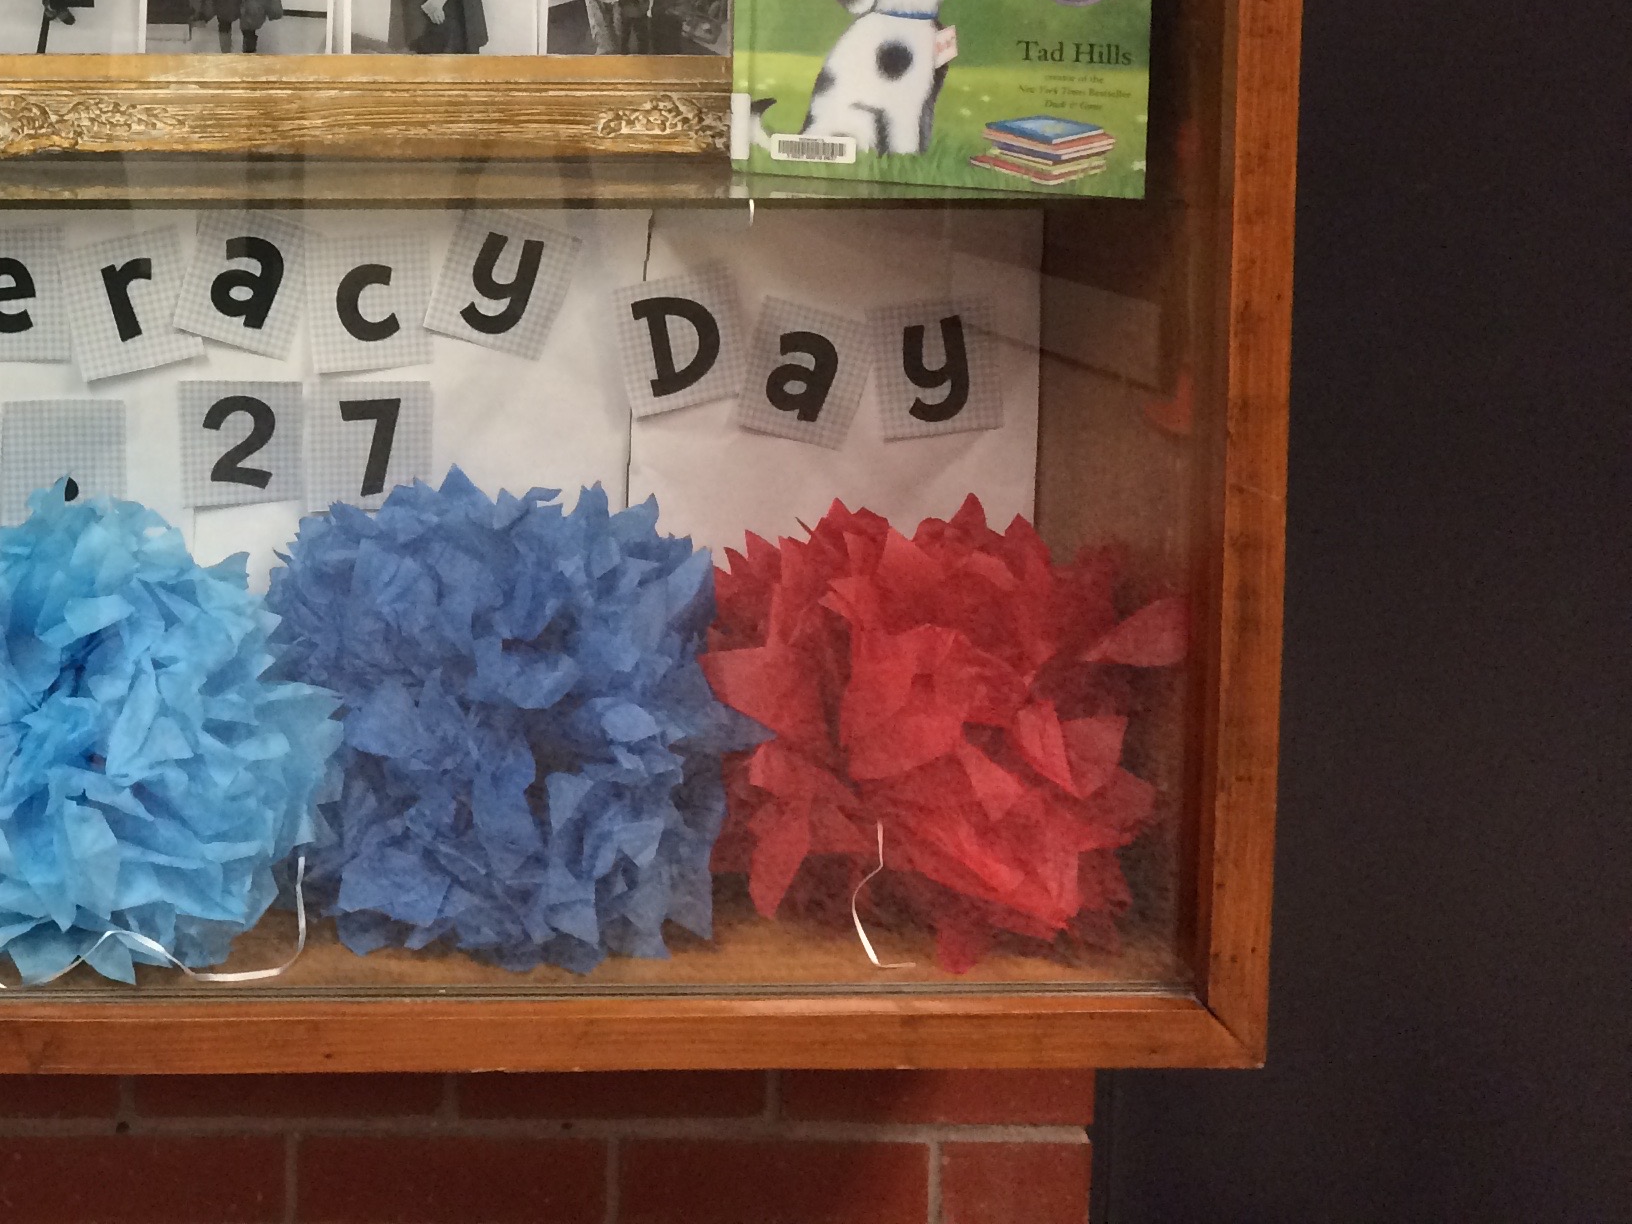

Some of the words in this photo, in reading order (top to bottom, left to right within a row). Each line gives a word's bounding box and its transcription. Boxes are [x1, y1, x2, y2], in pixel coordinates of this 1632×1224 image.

[1016, 40, 1065, 62] Tad
[1072, 42, 1134, 66] Hills
[630, 295, 970, 424] Day
[201, 394, 402, 497] 27
